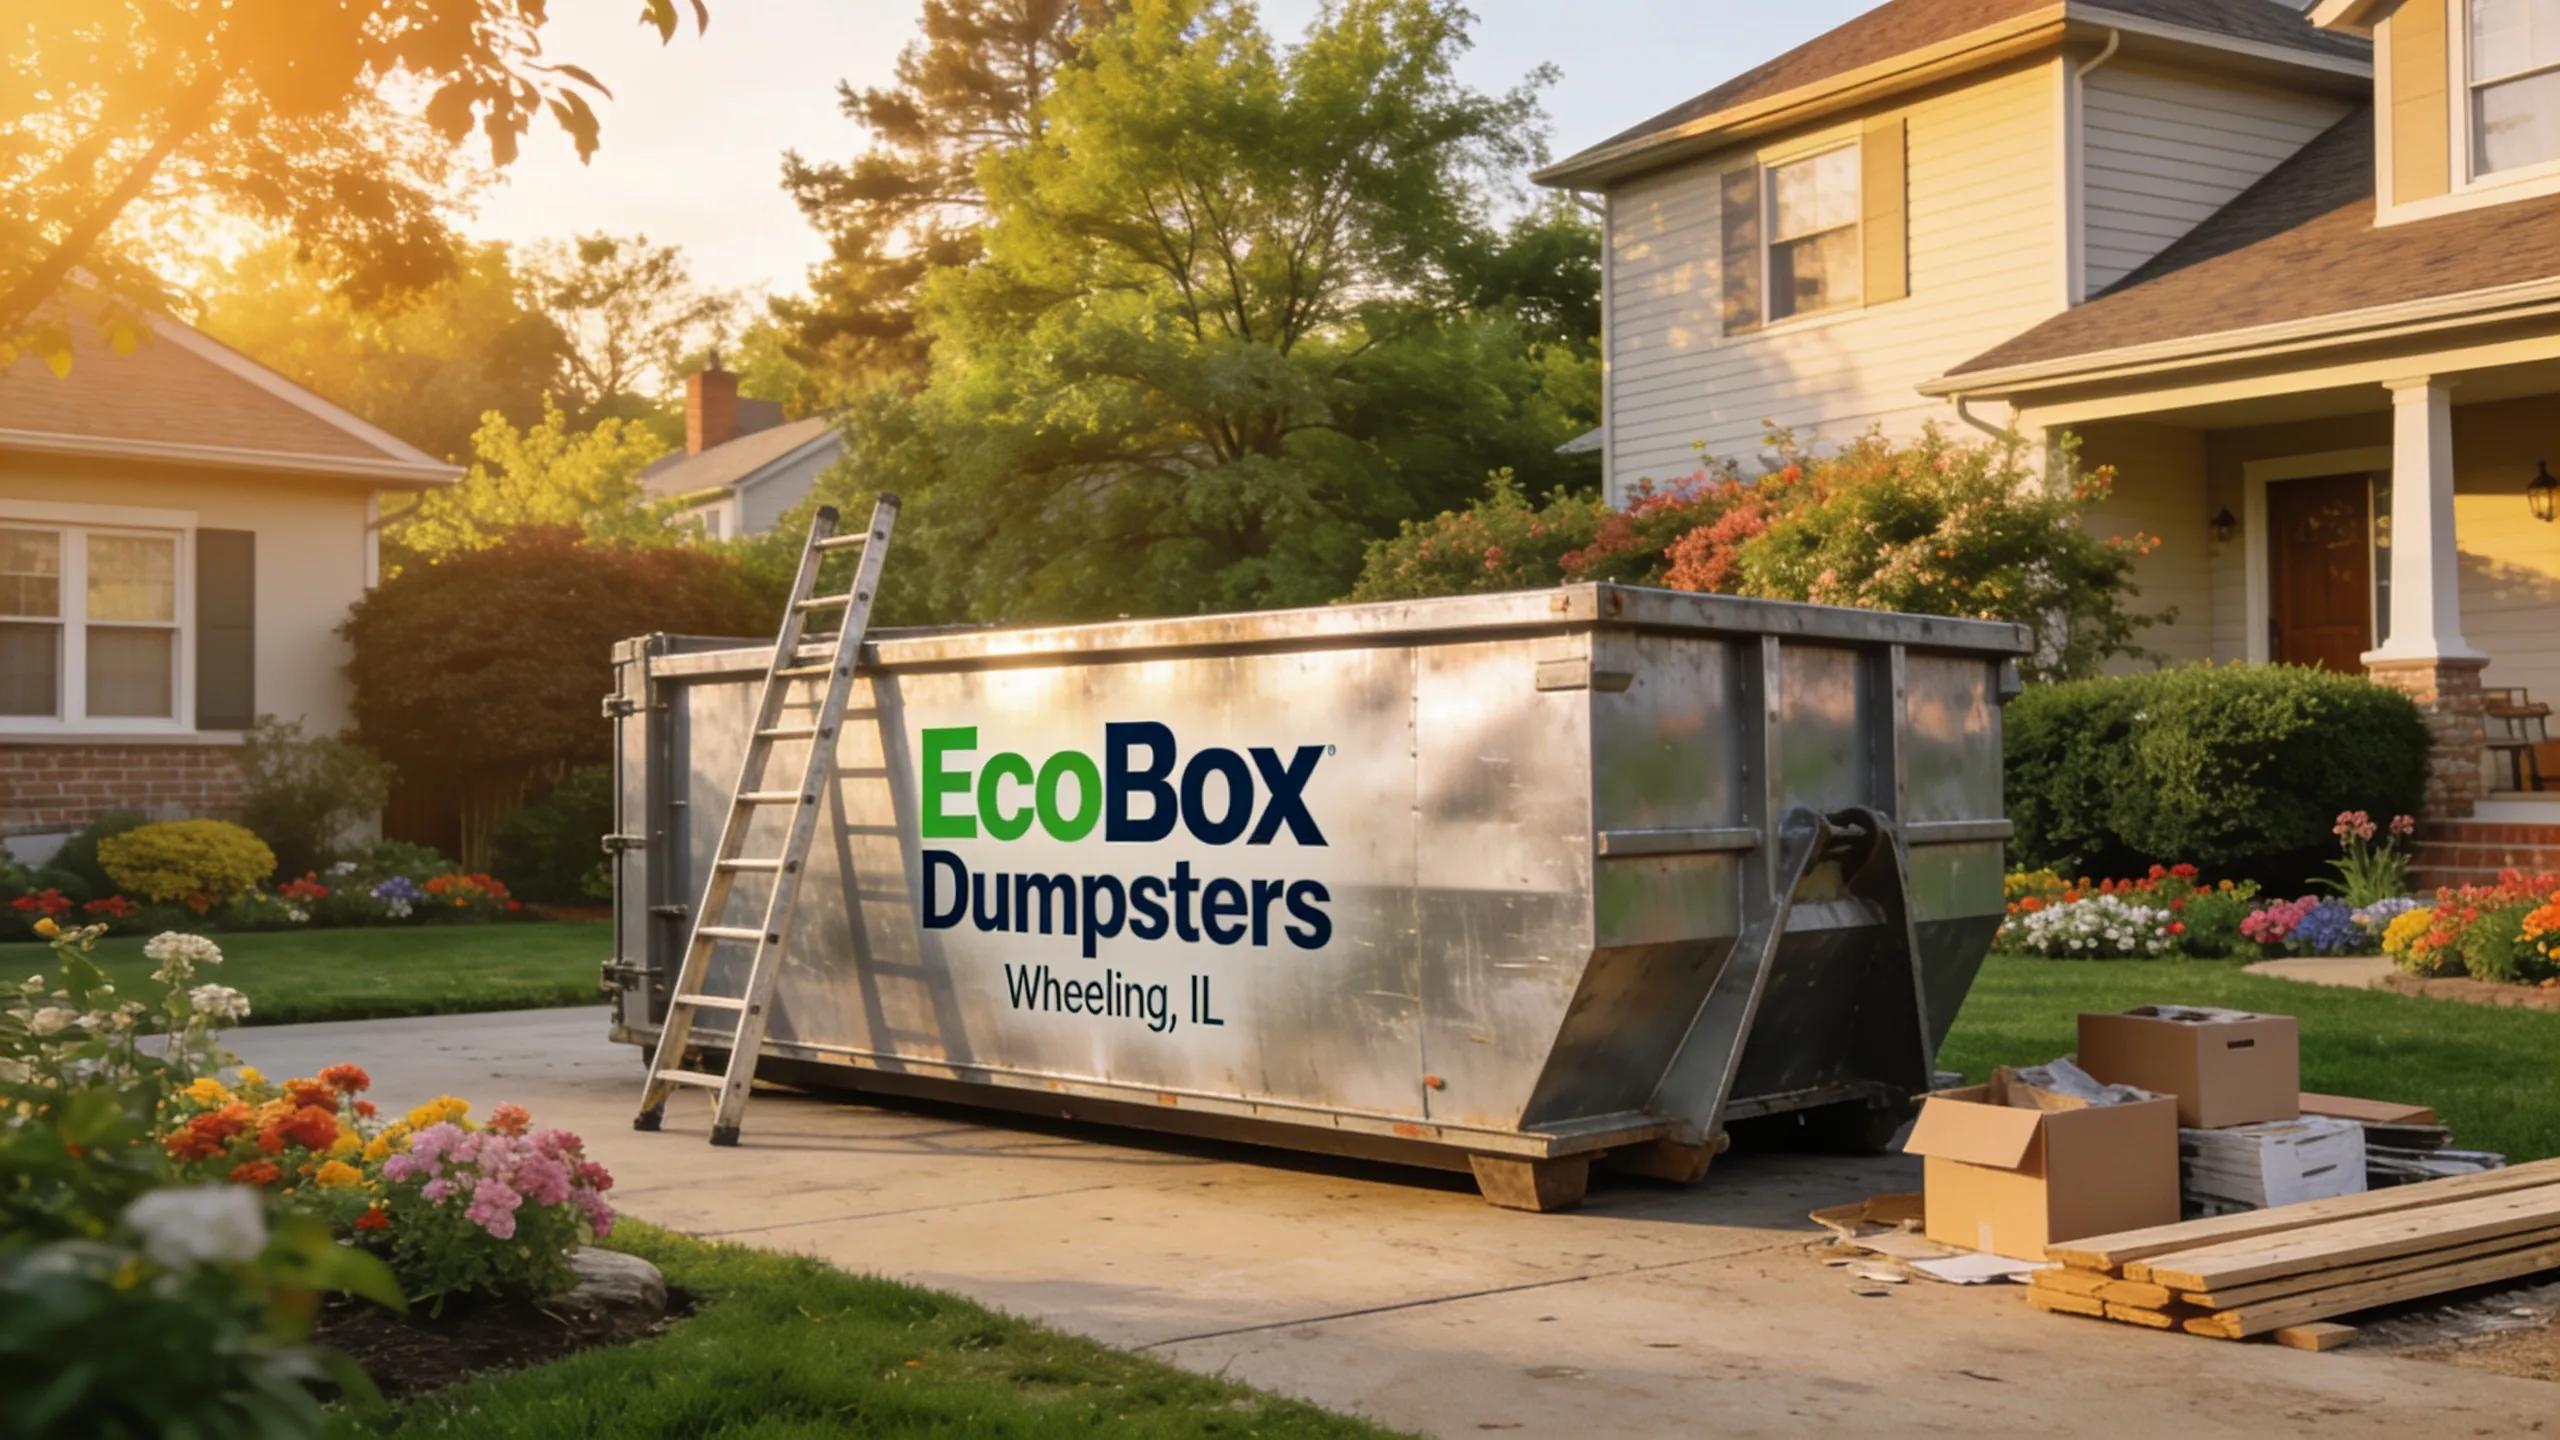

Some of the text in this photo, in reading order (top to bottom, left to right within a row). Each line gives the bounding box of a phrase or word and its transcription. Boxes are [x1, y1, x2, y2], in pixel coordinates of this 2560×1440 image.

[921, 721, 1329, 847] EcoBox
[921, 849, 1333, 959] Dumpsters
[1004, 963, 1225, 1034] Wheeling, IL
